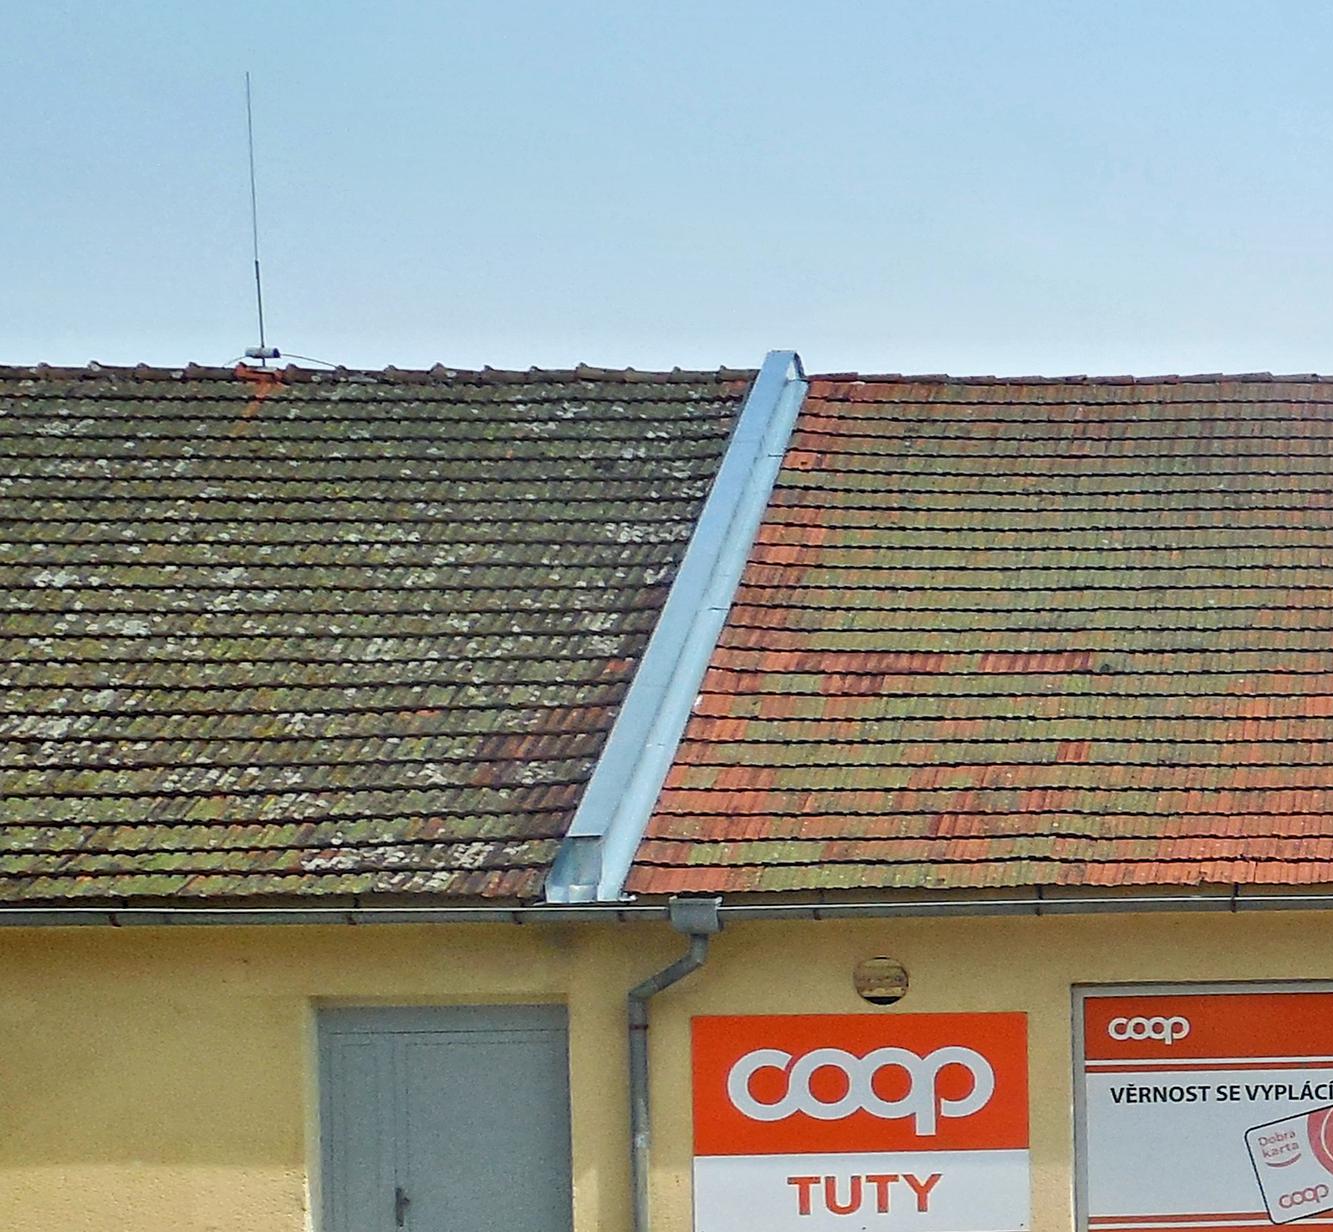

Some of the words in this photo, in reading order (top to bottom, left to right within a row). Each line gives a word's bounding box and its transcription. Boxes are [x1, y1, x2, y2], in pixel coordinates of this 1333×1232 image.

[1108, 1016, 1190, 1045] coop
[726, 1046, 995, 1136] coop
[1110, 1084, 1211, 1104] VĚRNOST
[1216, 1085, 1241, 1102] SE
[1261, 1142, 1300, 1158] karta
[787, 1173, 942, 1216] TUTY
[1278, 1183, 1330, 1209] coop
